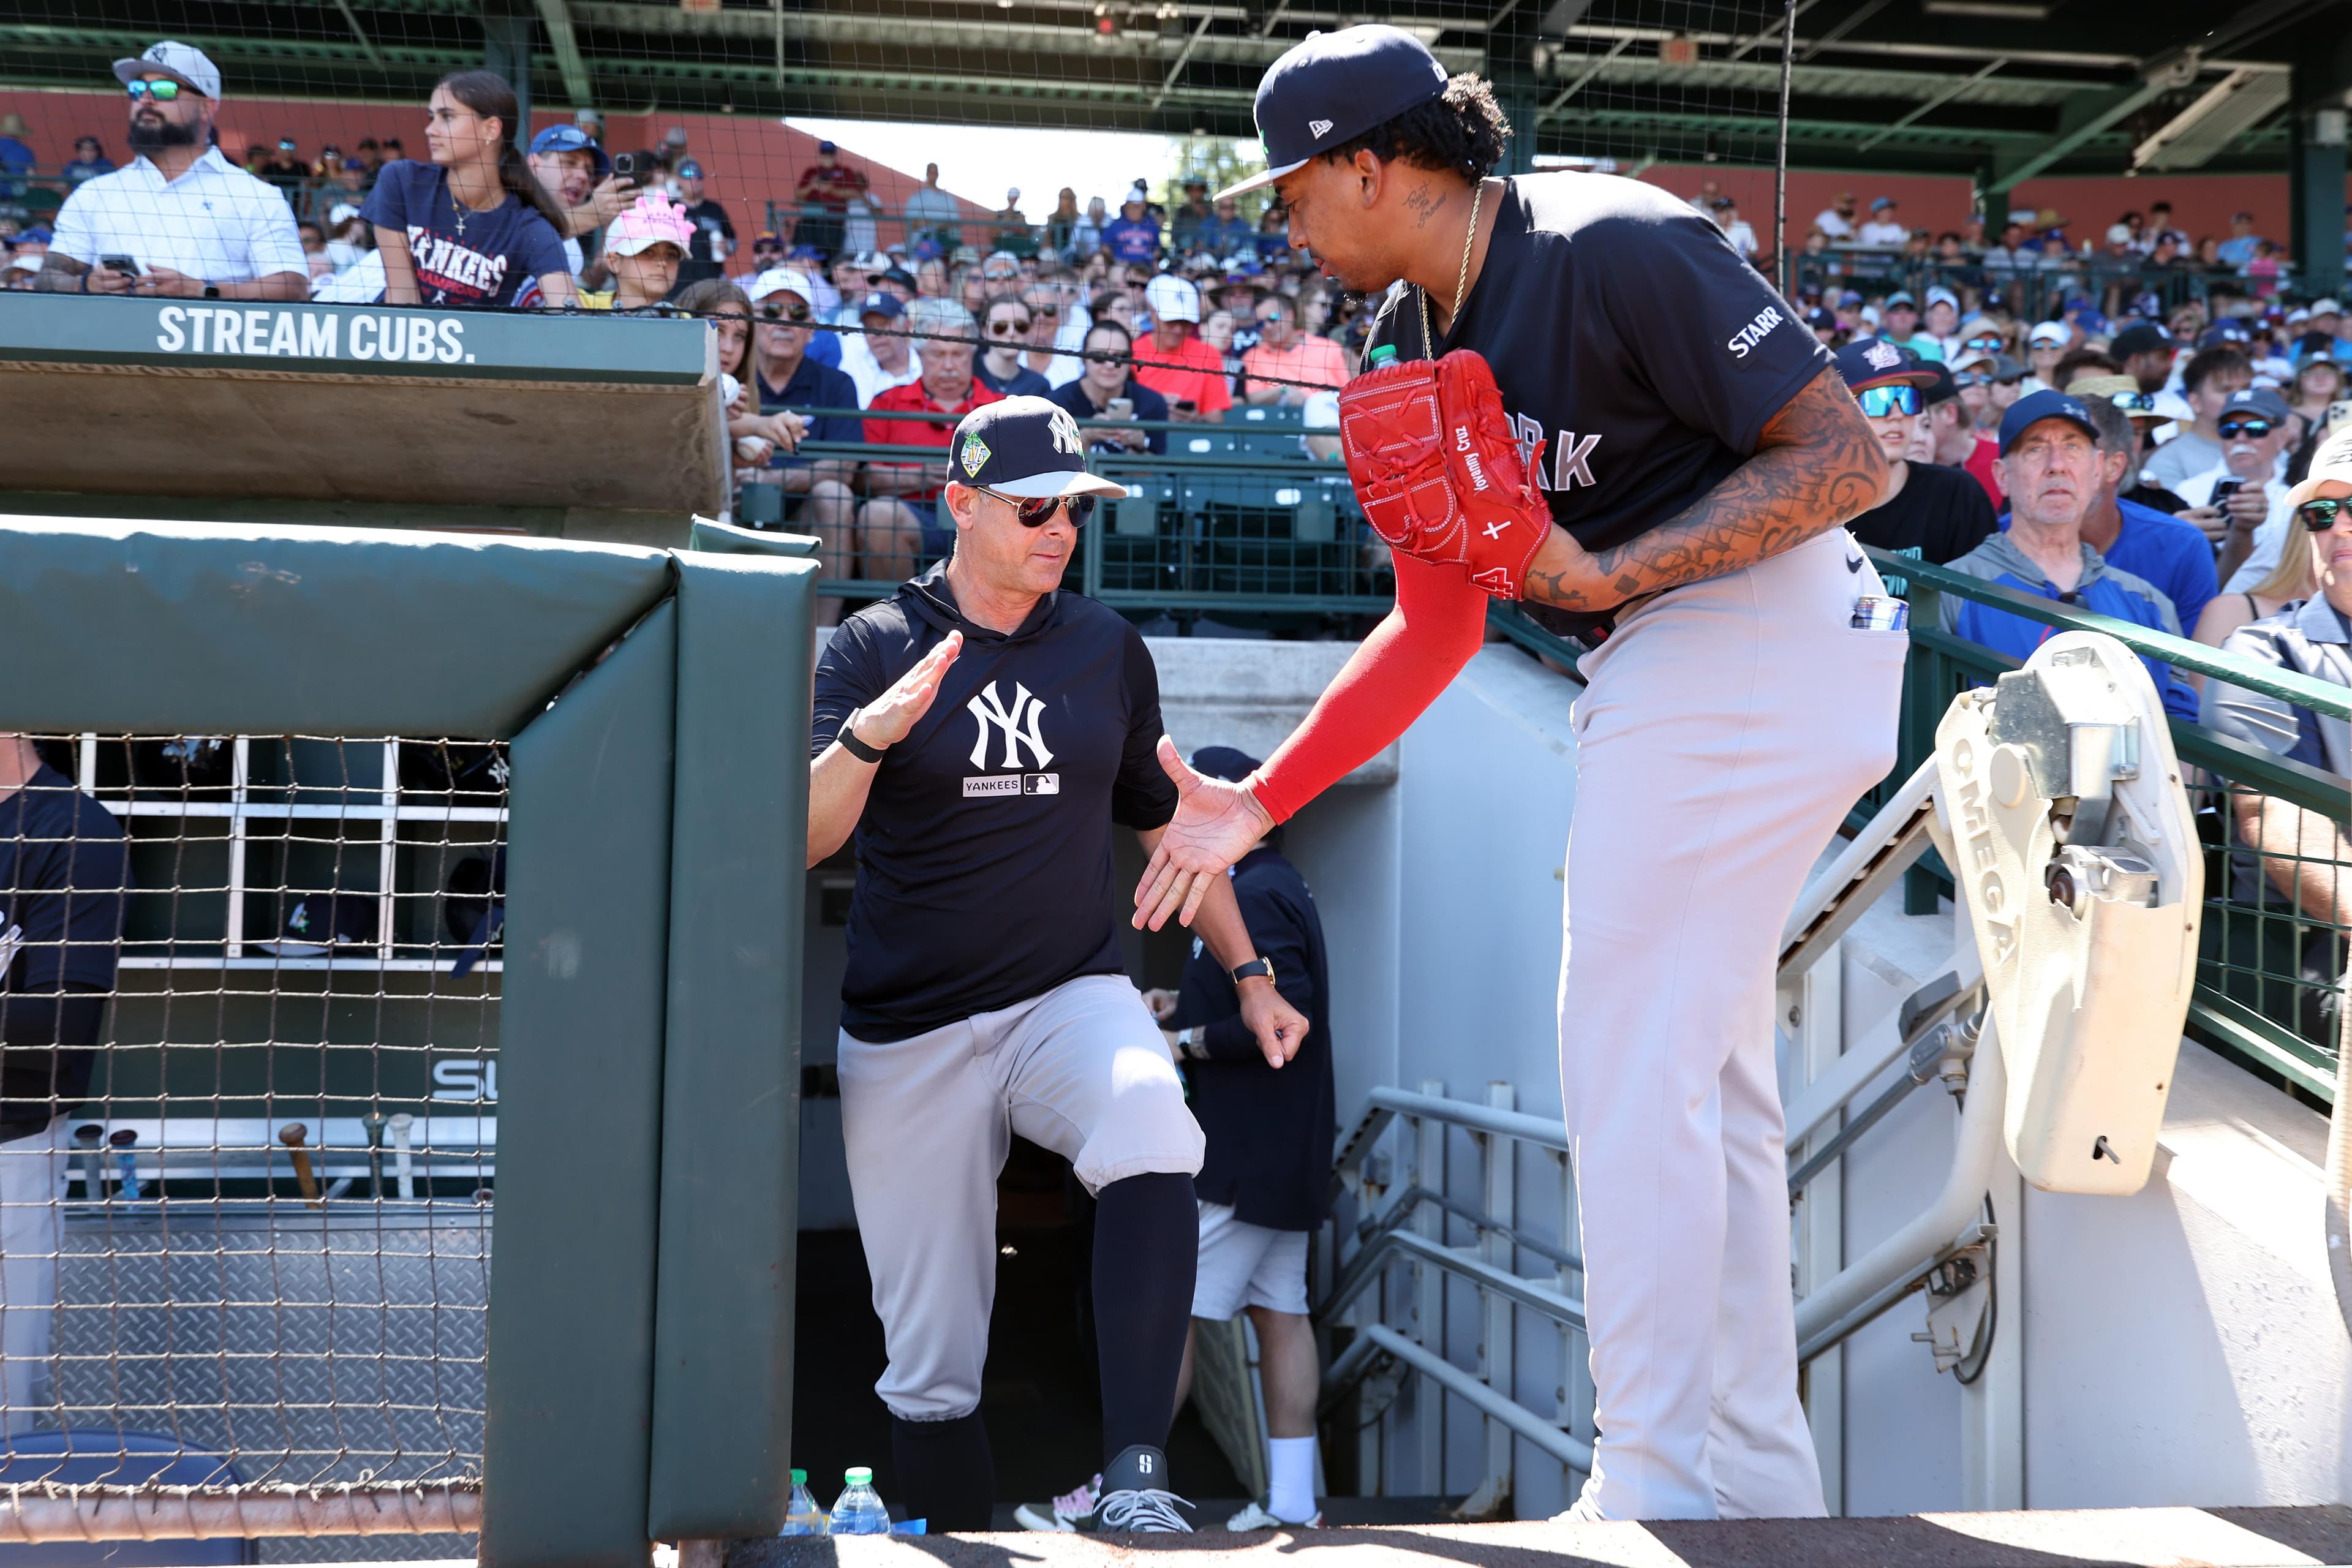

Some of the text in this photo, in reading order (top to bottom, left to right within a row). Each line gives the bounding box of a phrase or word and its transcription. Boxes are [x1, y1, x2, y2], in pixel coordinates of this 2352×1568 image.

[407, 224, 507, 298] YANKEES
[157, 306, 475, 363] STREAM CUBS.
[1728, 306, 1784, 358] STARR
[1455, 424, 1490, 491] Yovanny Cruz
[966, 780, 1019, 791] YANKEES
[1952, 738, 2022, 967] OMEGA
